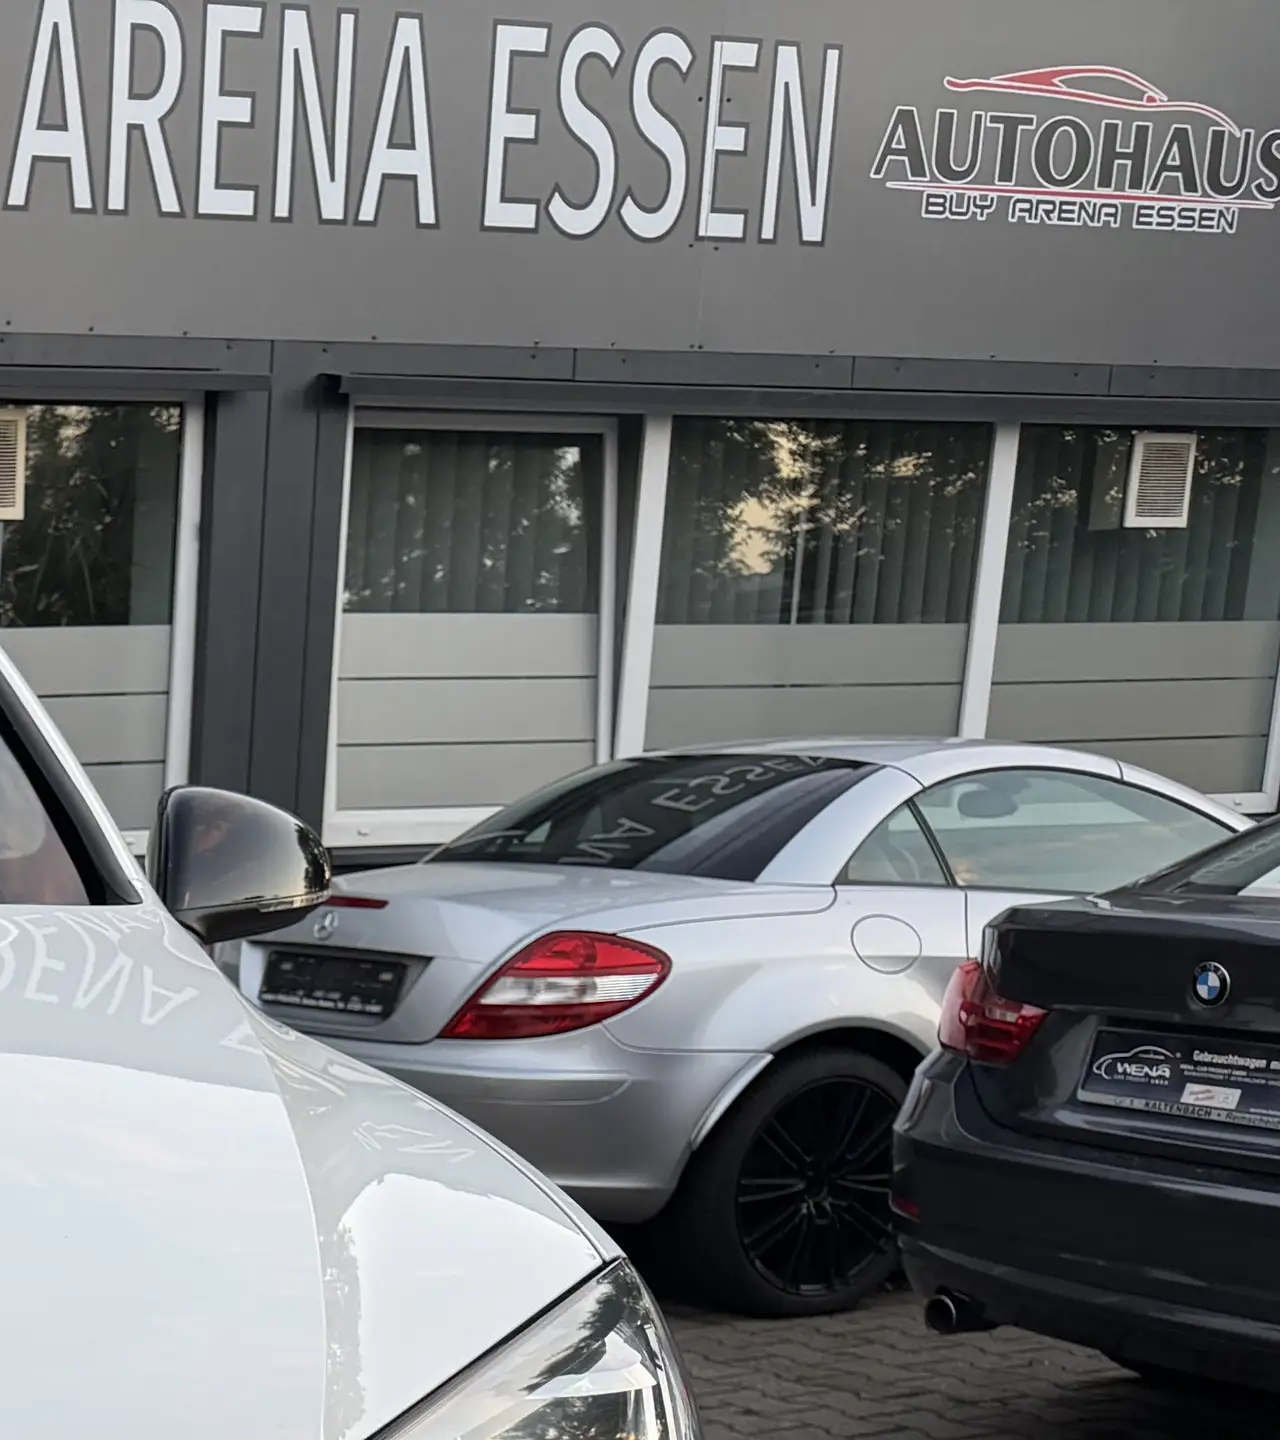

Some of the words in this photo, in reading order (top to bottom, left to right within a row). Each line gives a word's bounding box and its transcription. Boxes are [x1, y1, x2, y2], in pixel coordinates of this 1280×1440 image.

[5, 0, 438, 226] ARENA
[482, 22, 840, 243] ESSEN
[922, 190, 996, 220] BUY
[1008, 197, 1122, 228] ARENA
[1133, 204, 1237, 233] ESSEN
[1116, 1061, 1171, 1078] WENA
